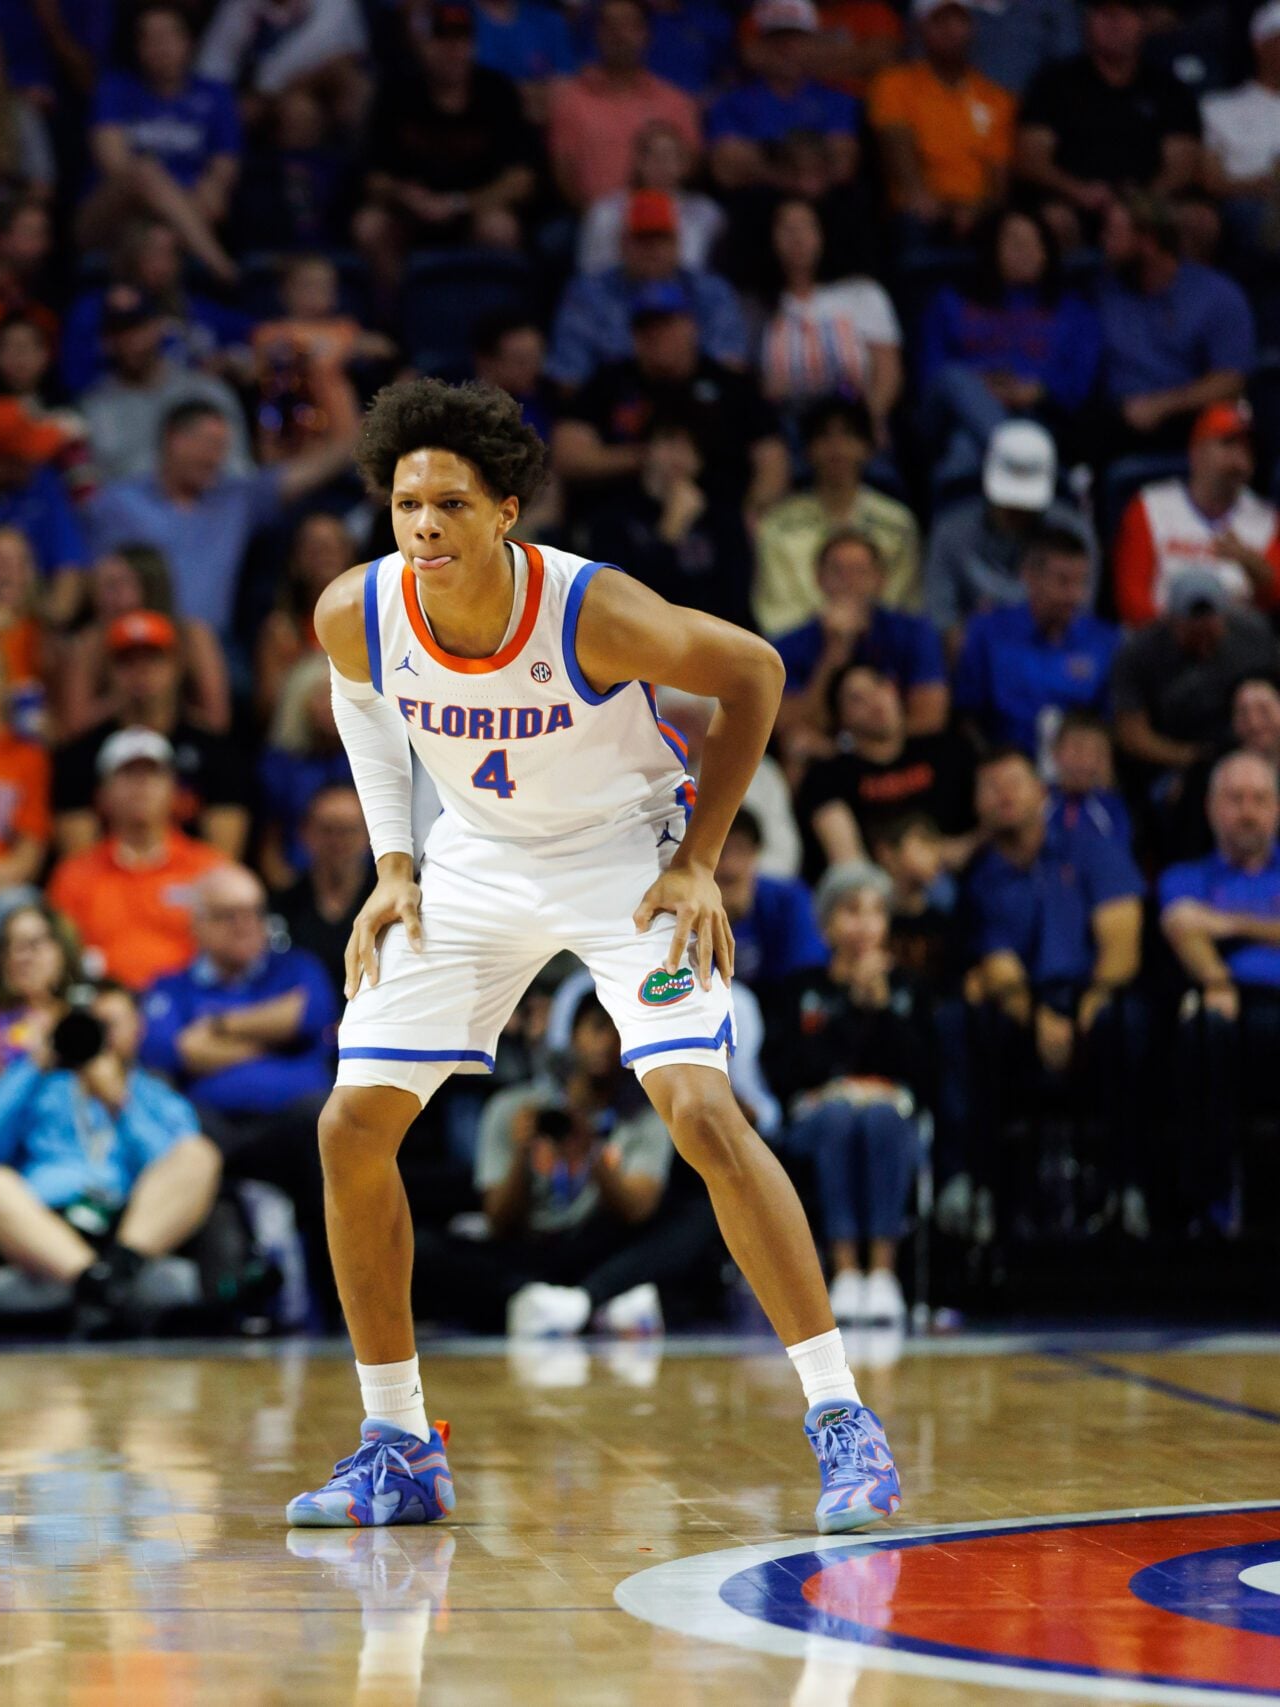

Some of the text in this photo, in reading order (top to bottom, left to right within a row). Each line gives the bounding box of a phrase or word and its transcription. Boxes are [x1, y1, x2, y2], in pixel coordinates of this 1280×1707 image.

[531, 662, 551, 683] SEC
[396, 695, 574, 740] FLORIDA
[471, 748, 517, 799] 4
